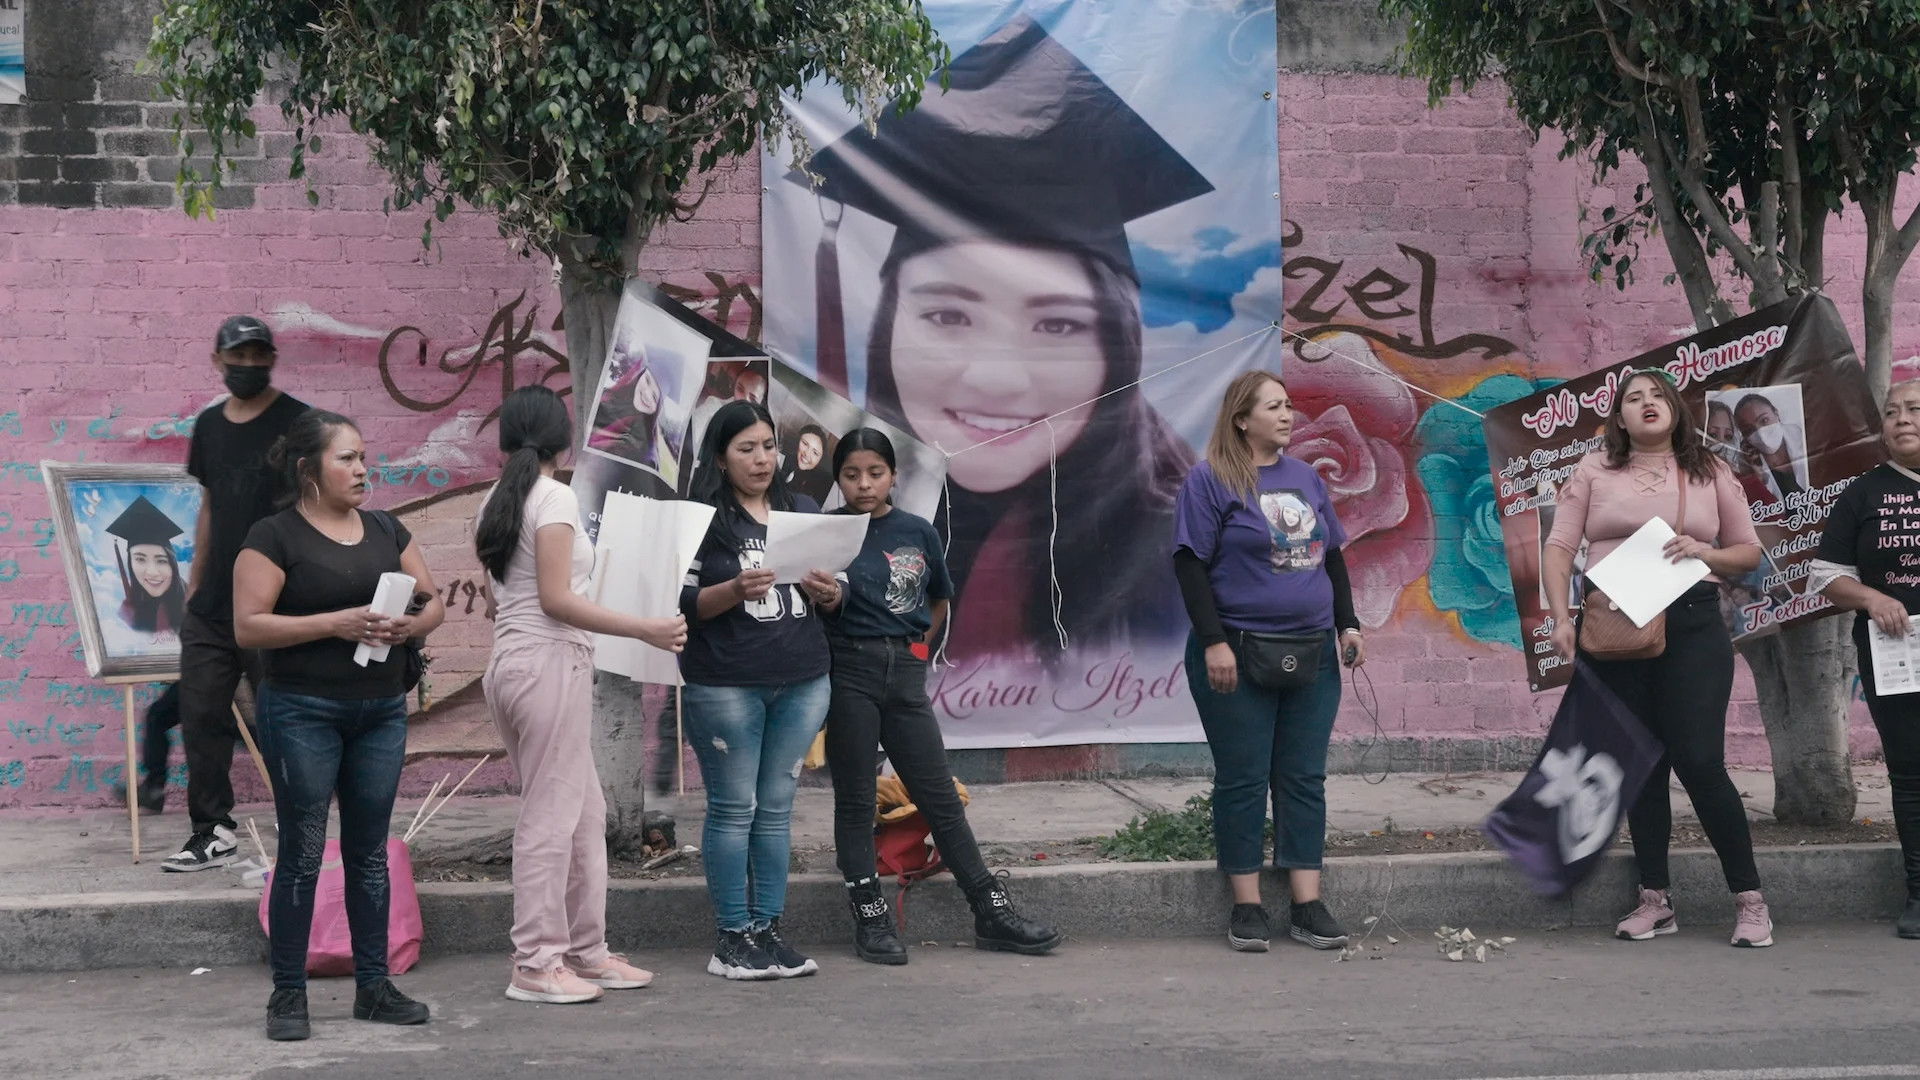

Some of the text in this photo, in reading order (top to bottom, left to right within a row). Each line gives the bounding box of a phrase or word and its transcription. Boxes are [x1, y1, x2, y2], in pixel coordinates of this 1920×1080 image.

[1522, 388, 1579, 438] Mi
[1663, 325, 1788, 392] Hermosa
[1530, 448, 1559, 469] Dios
[1560, 438, 1585, 459] sabe
[1501, 481, 1513, 498] te
[1526, 488, 1557, 509] mundo
[1750, 500, 1785, 522] Eres
[1785, 485, 1822, 510] todo
[1877, 508, 1894, 516] Tu
[1880, 520, 1897, 531] En
[1771, 530, 1823, 559] el dolo
[1742, 596, 1771, 632] Te
[931, 651, 1185, 720] Karen Itzel
